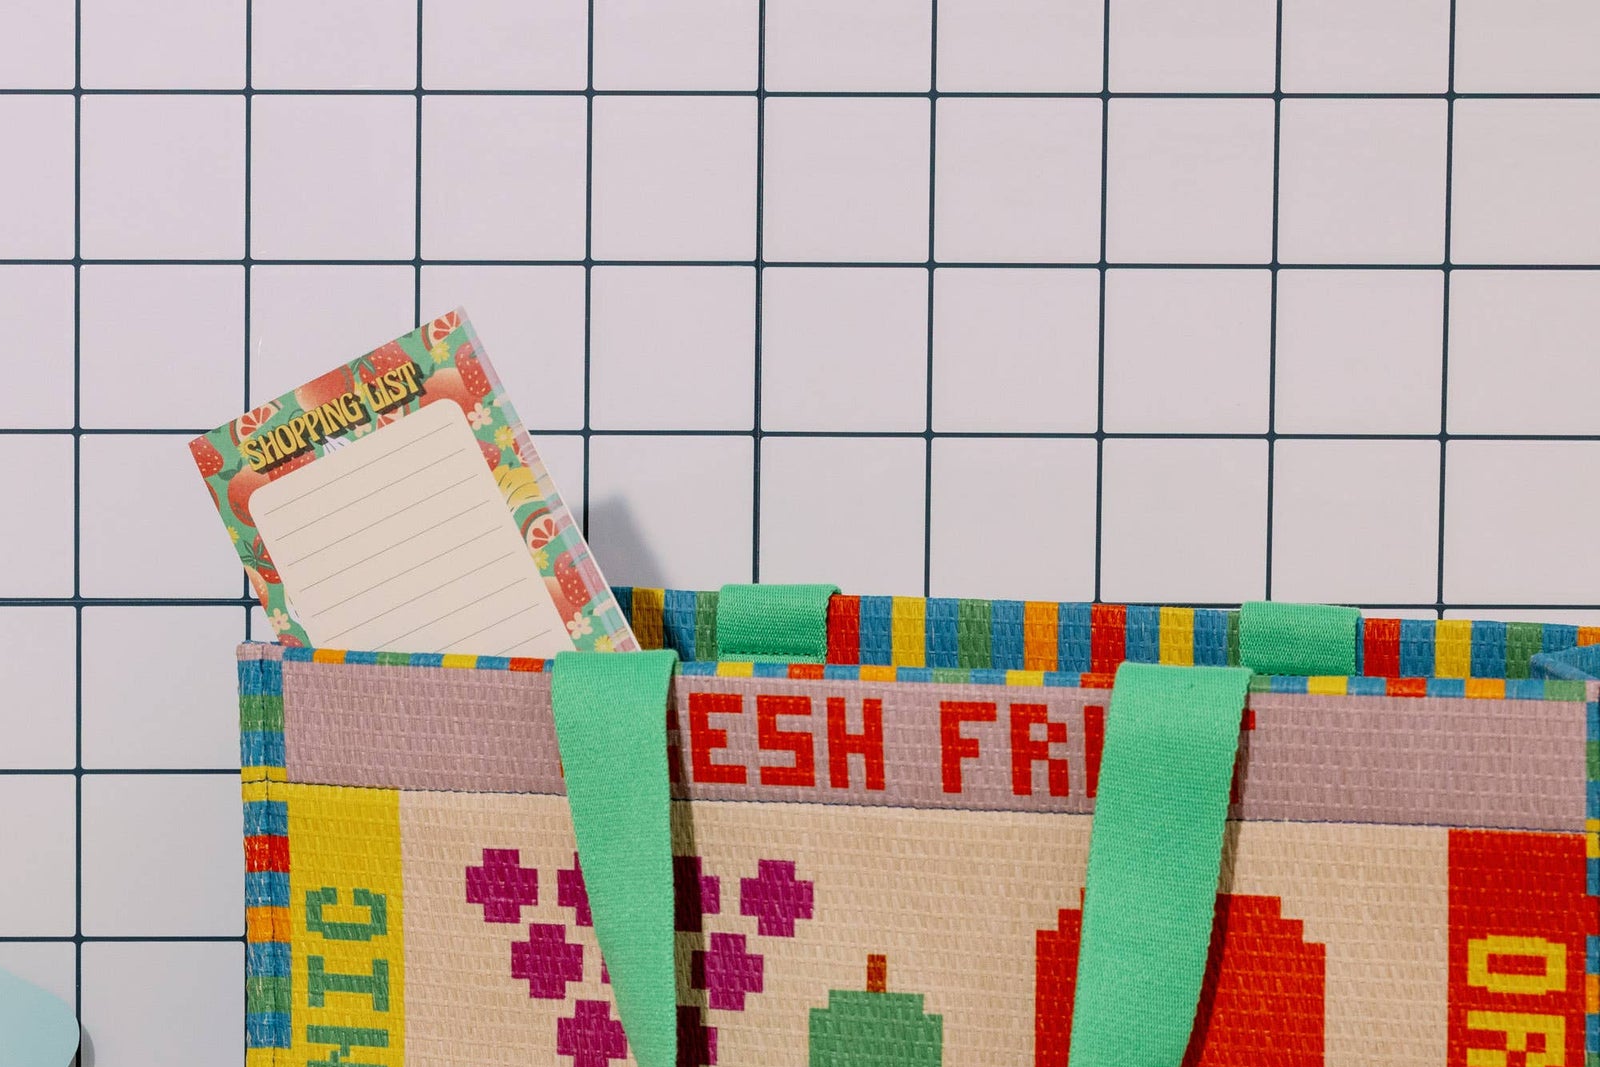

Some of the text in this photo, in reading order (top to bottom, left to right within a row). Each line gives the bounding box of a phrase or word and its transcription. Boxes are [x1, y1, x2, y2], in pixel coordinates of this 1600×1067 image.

[243, 361, 426, 474] SHOPPING LIST
[667, 692, 885, 791] ESH
